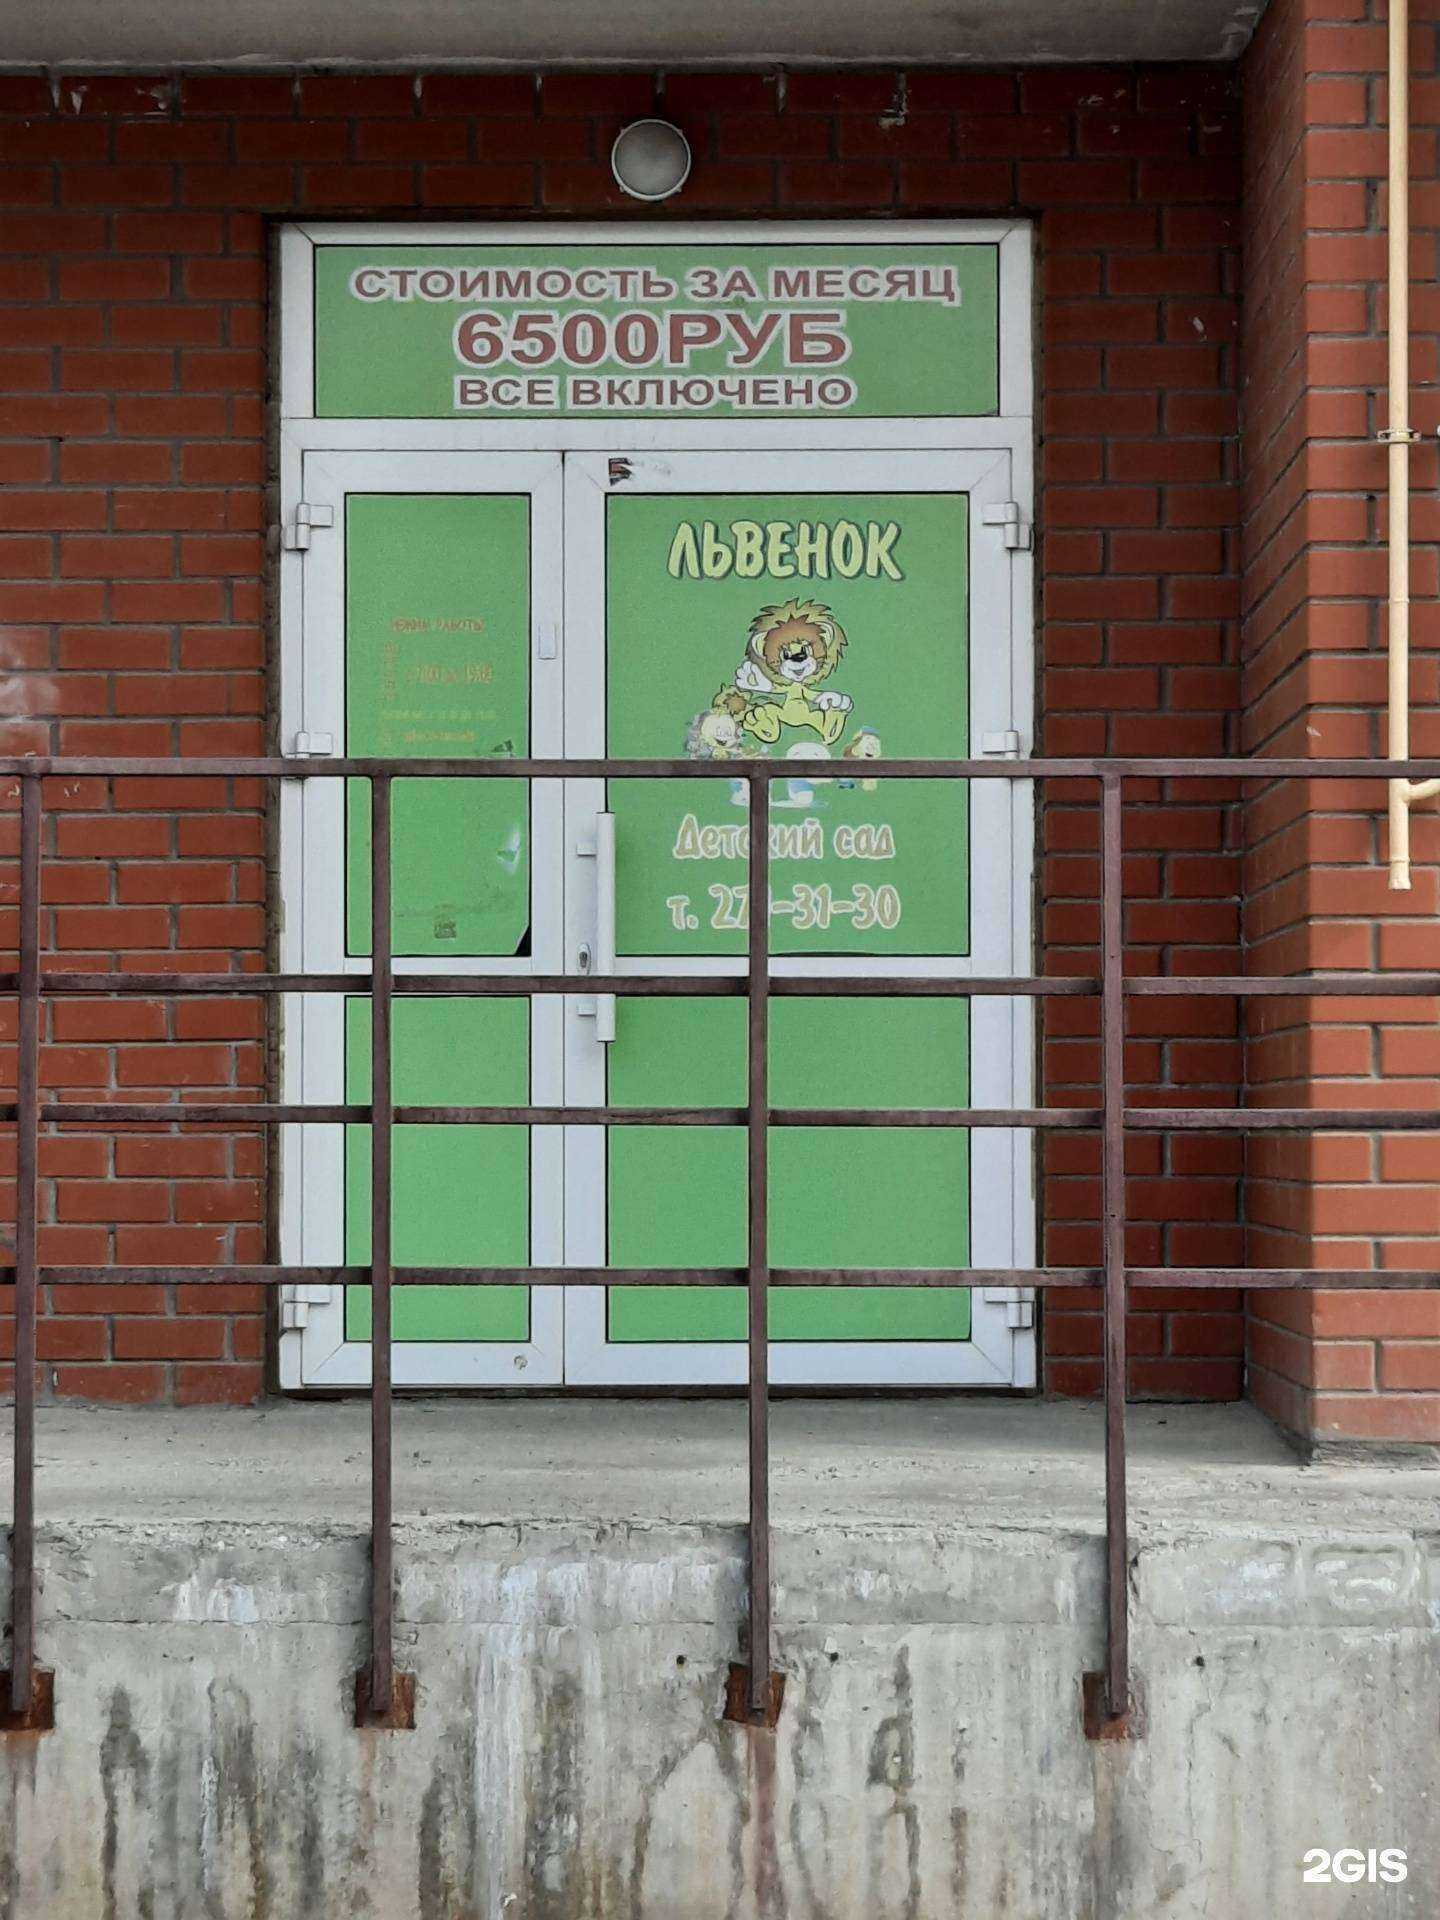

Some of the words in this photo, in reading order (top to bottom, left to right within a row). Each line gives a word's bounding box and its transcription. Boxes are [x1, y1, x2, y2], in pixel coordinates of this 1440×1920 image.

[350, 267, 677, 301] СТОИМОСТЬ
[688, 267, 765, 301] ЗА
[769, 267, 960, 306] МЕСЯЦ
[453, 310, 851, 368] 6500РУБ
[455, 376, 560, 410] ВСЕ
[567, 376, 857, 410] ВКЛЮЧЕНО
[667, 520, 905, 580] ЛЬВЕНОК
[834, 823, 895, 859] сад
[708, 884, 901, 929] 27-31-30
